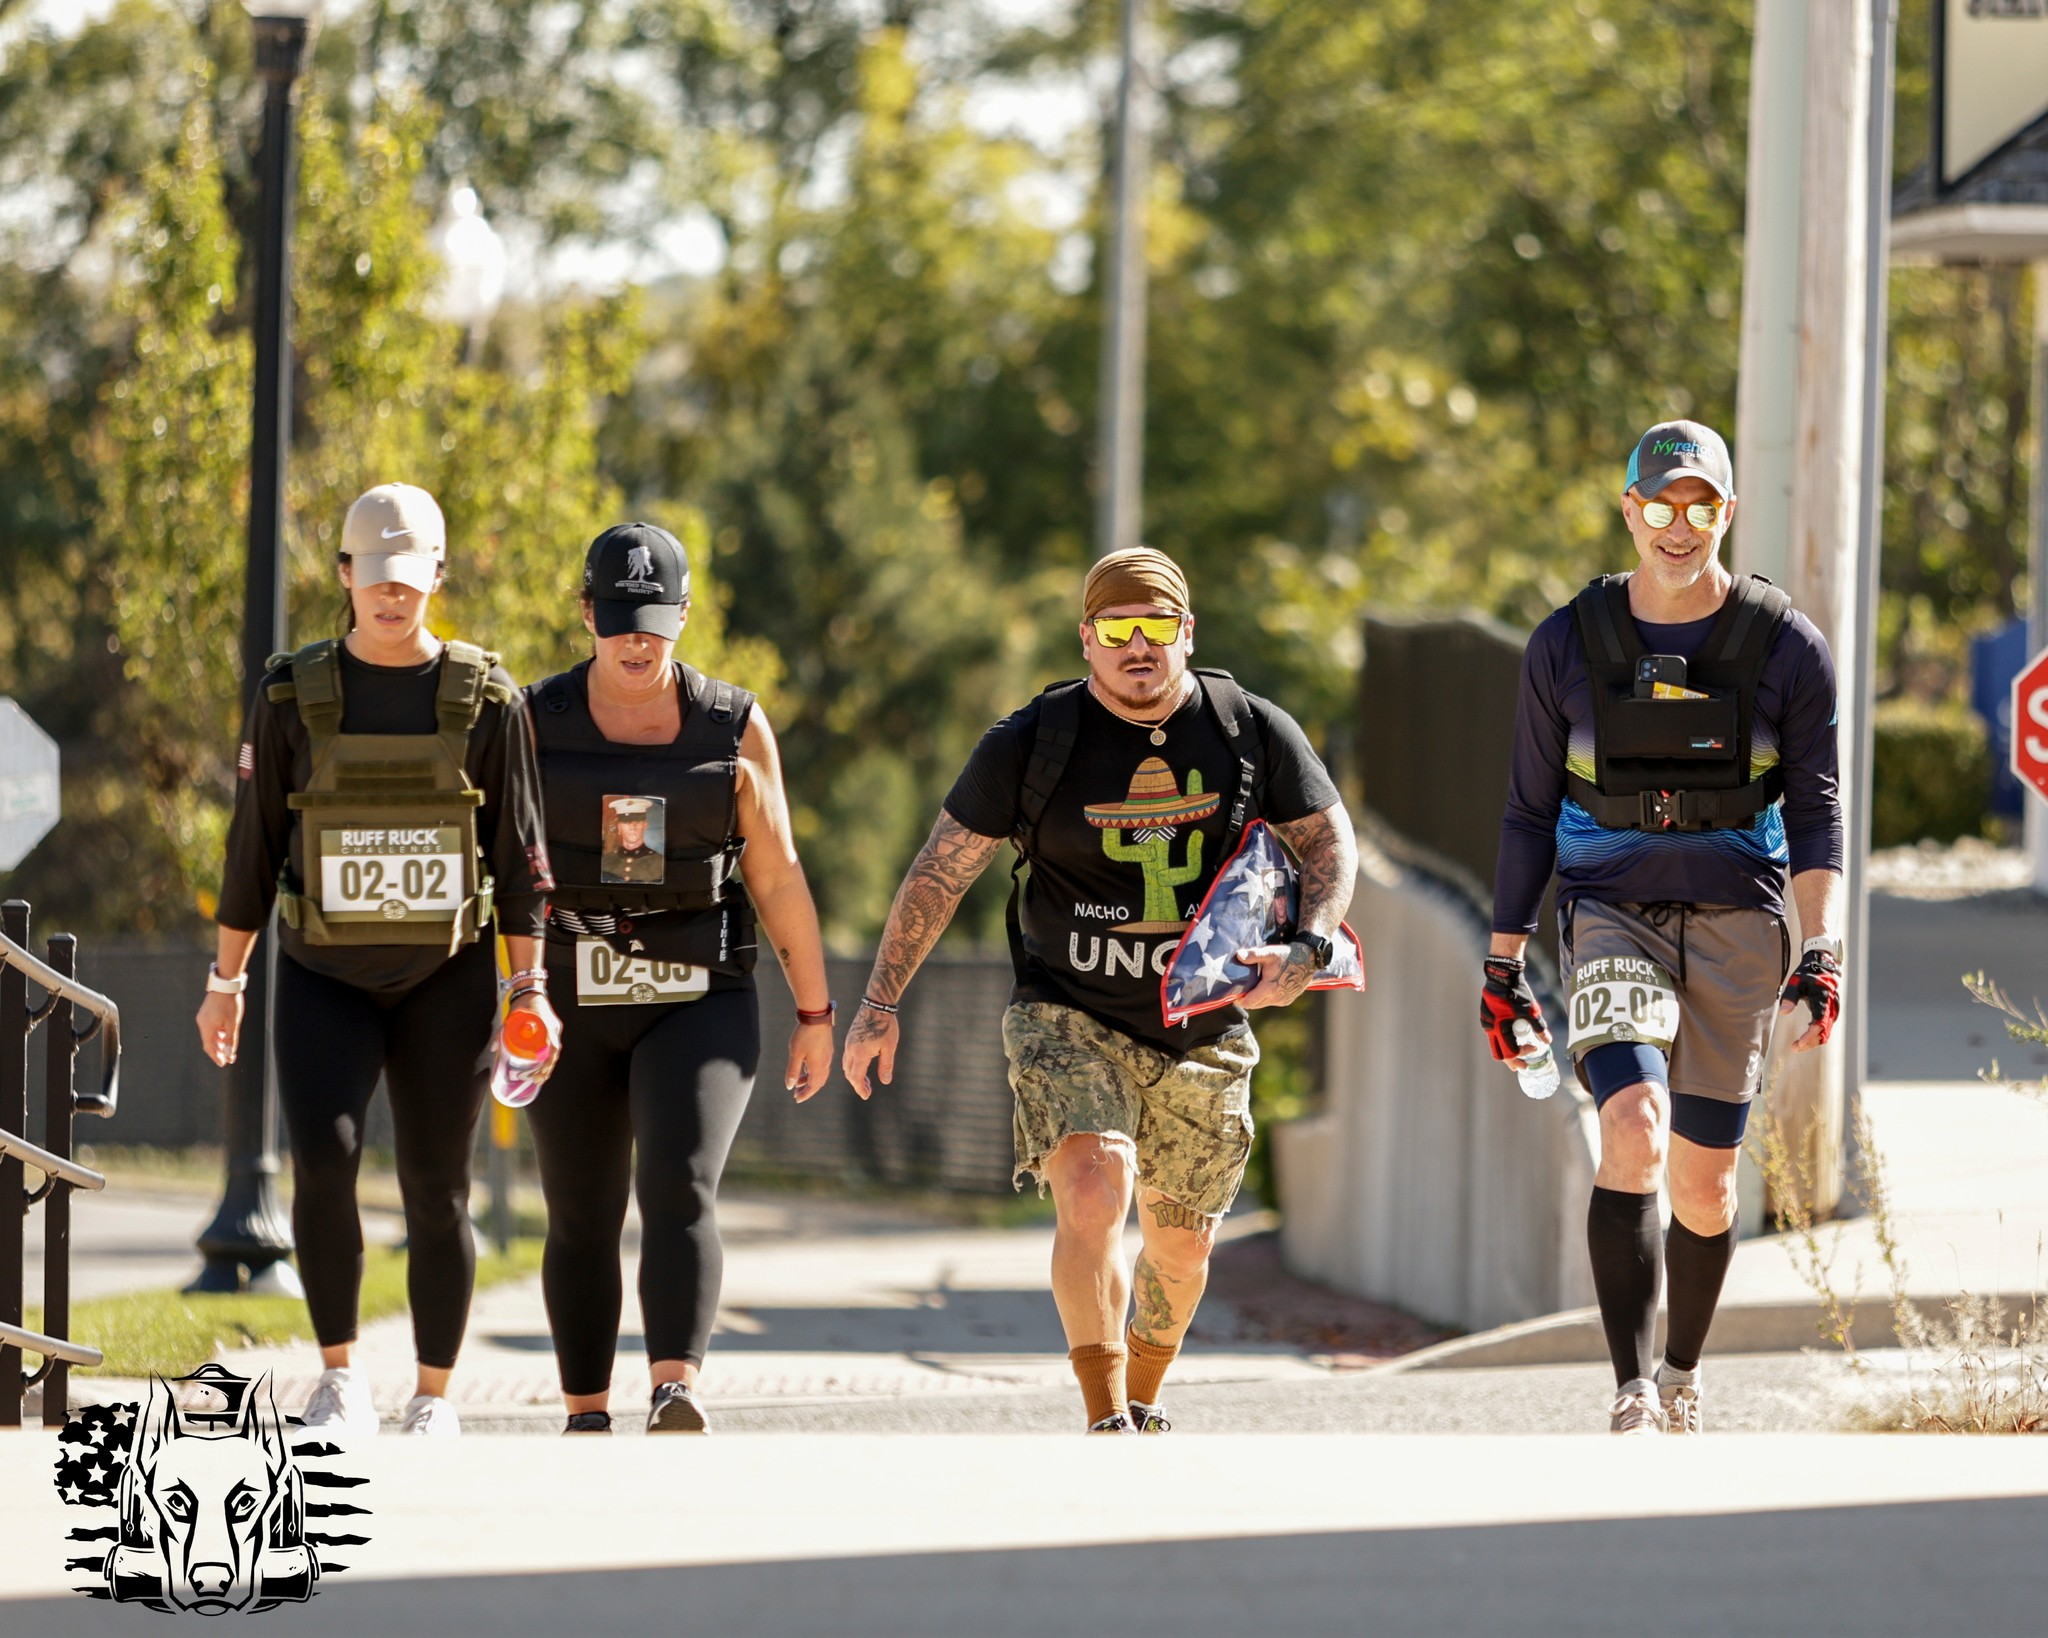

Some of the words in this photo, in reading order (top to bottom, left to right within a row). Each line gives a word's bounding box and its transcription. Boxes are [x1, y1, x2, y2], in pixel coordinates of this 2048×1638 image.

[341, 830, 385, 846] RUFF
[388, 829, 439, 846] RUCK
[341, 846, 443, 854] CHALLENGE
[339, 859, 447, 901] 02-02
[1074, 902, 1129, 920] NACHO
[1576, 959, 1610, 983] RUFF
[1614, 958, 1657, 978] RUCK
[1576, 972, 1660, 990] CHALLENGE
[1575, 986, 1666, 1031] 02-04
